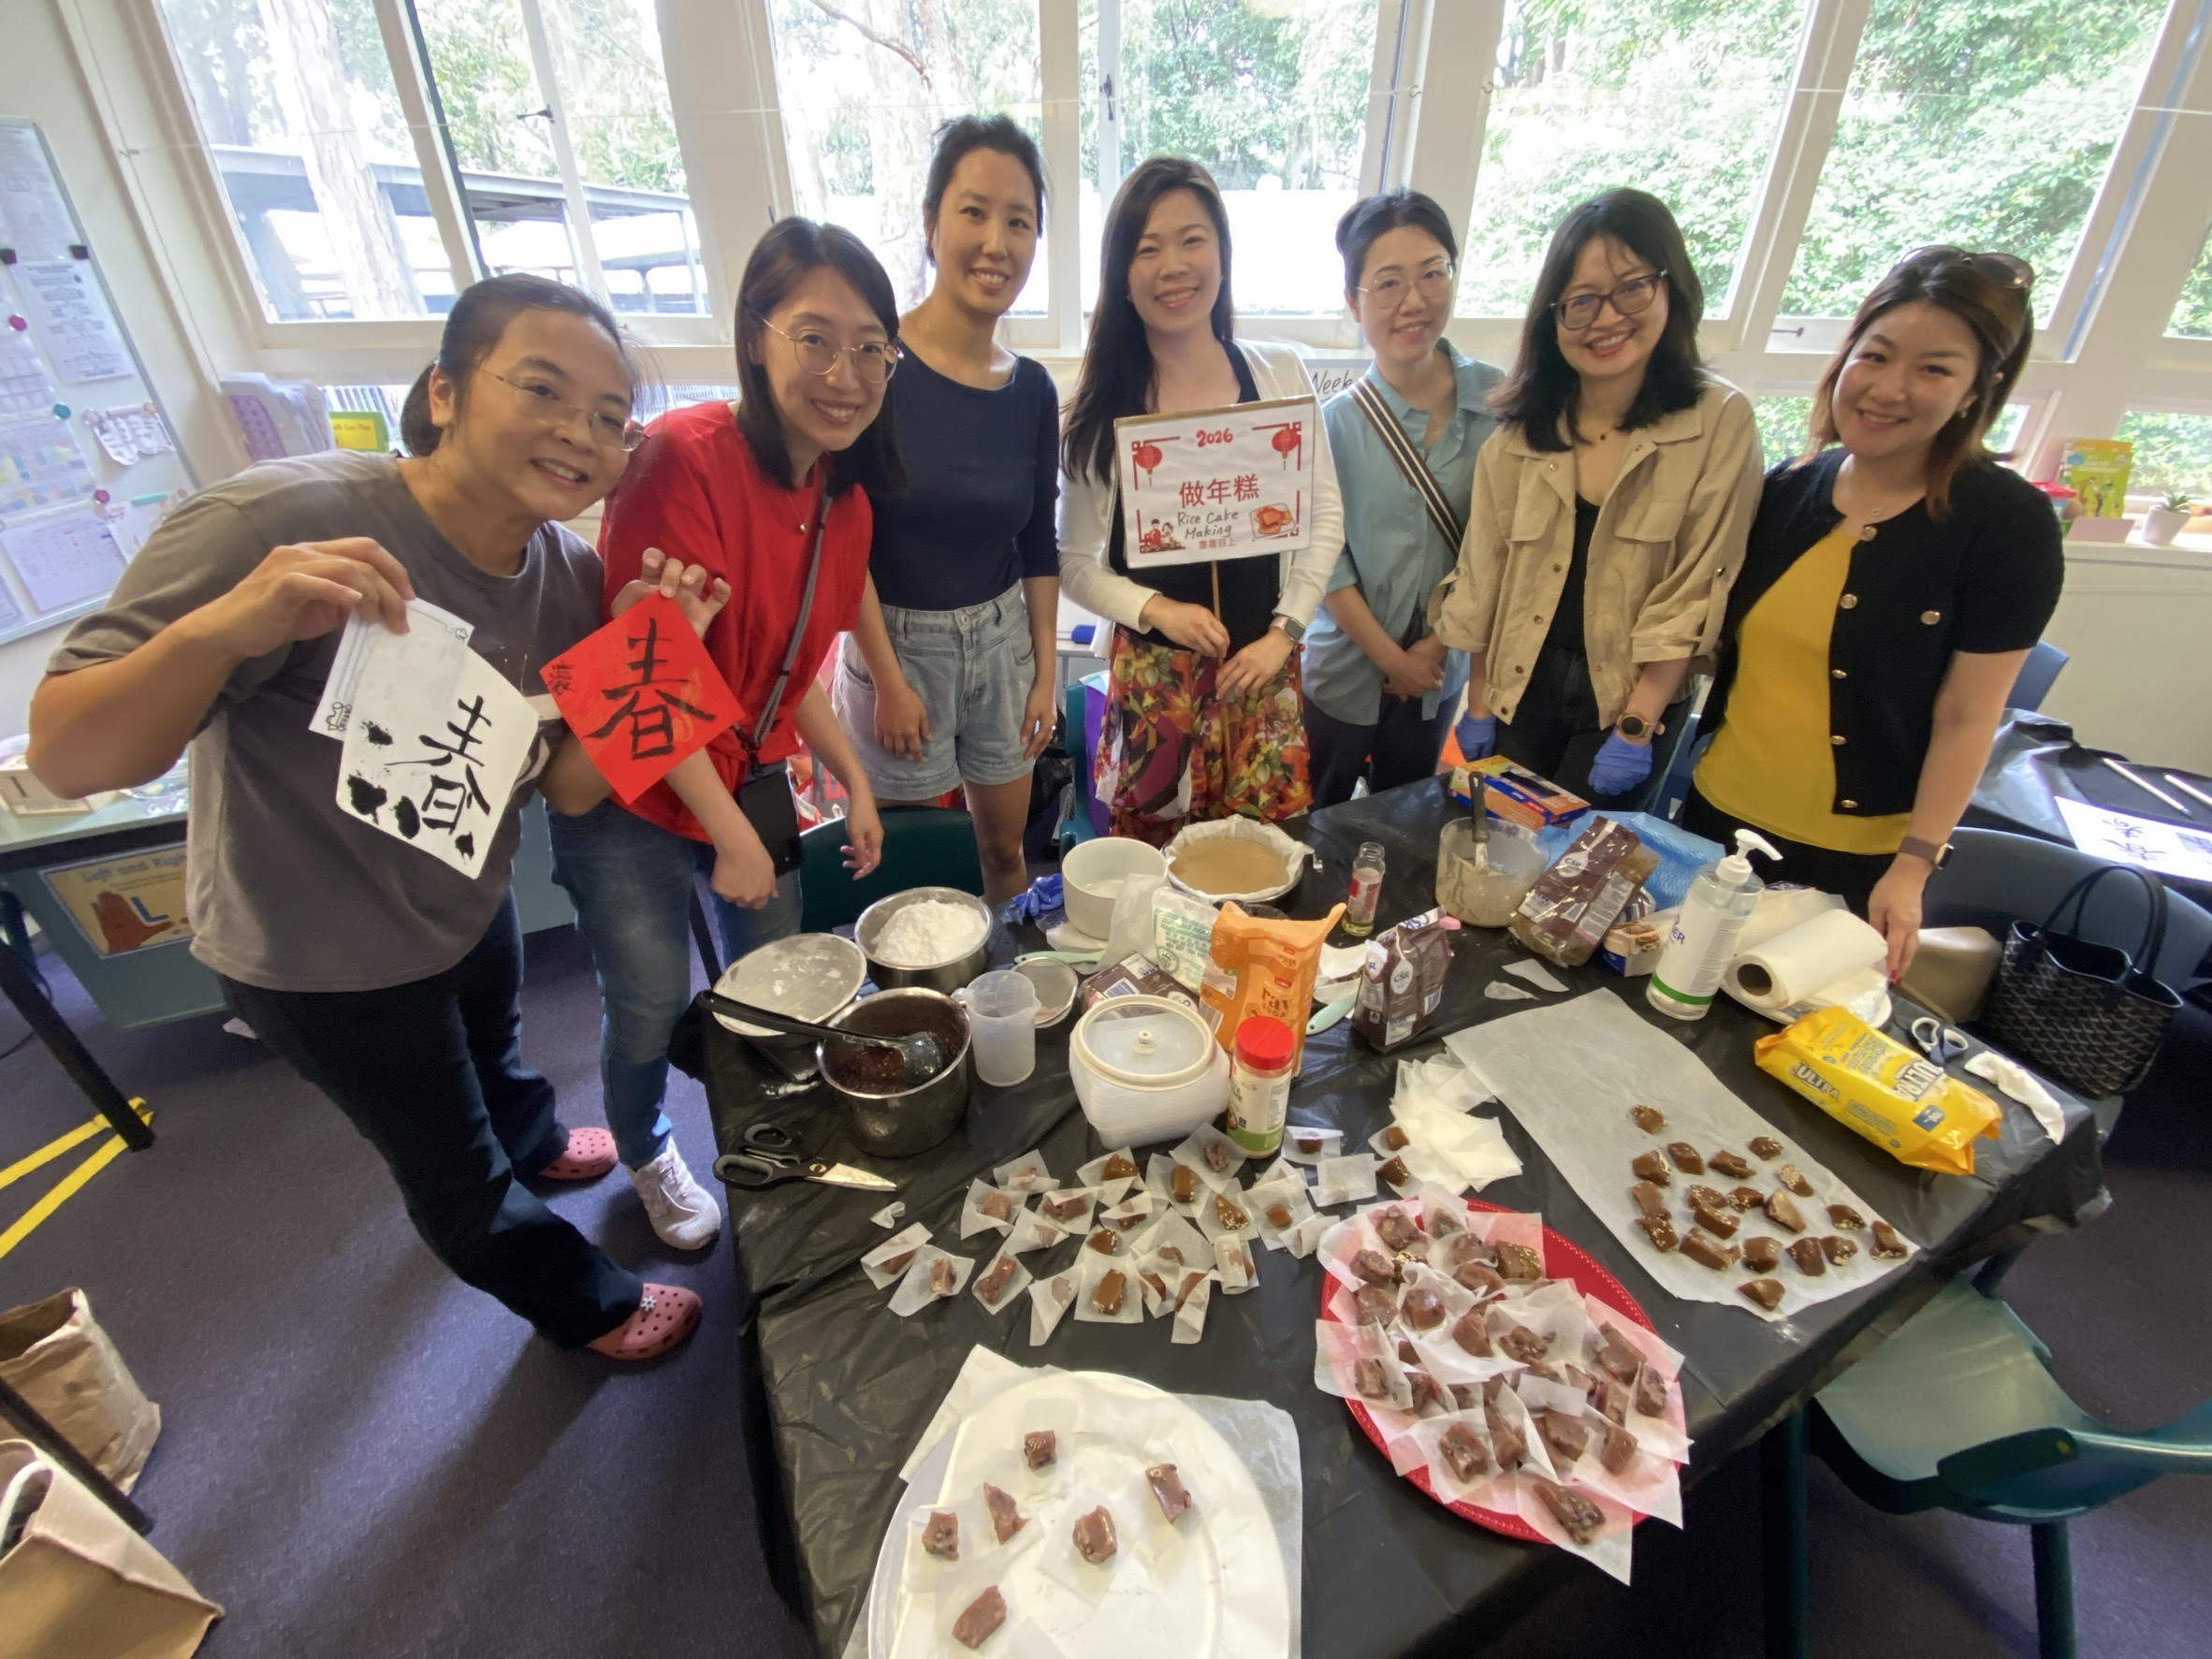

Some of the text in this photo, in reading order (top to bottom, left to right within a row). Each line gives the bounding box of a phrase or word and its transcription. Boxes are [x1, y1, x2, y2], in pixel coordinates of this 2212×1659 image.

[1196, 428, 1233, 447] 2026
[1178, 473, 1259, 509] 做年糕
[1177, 508, 1239, 526] Rice Cake
[1185, 524, 1232, 540] Making
[583, 618, 716, 760] 春
[1796, 1063, 1841, 1100] ULTRA
[1894, 1058, 1944, 1102] ULTRA
